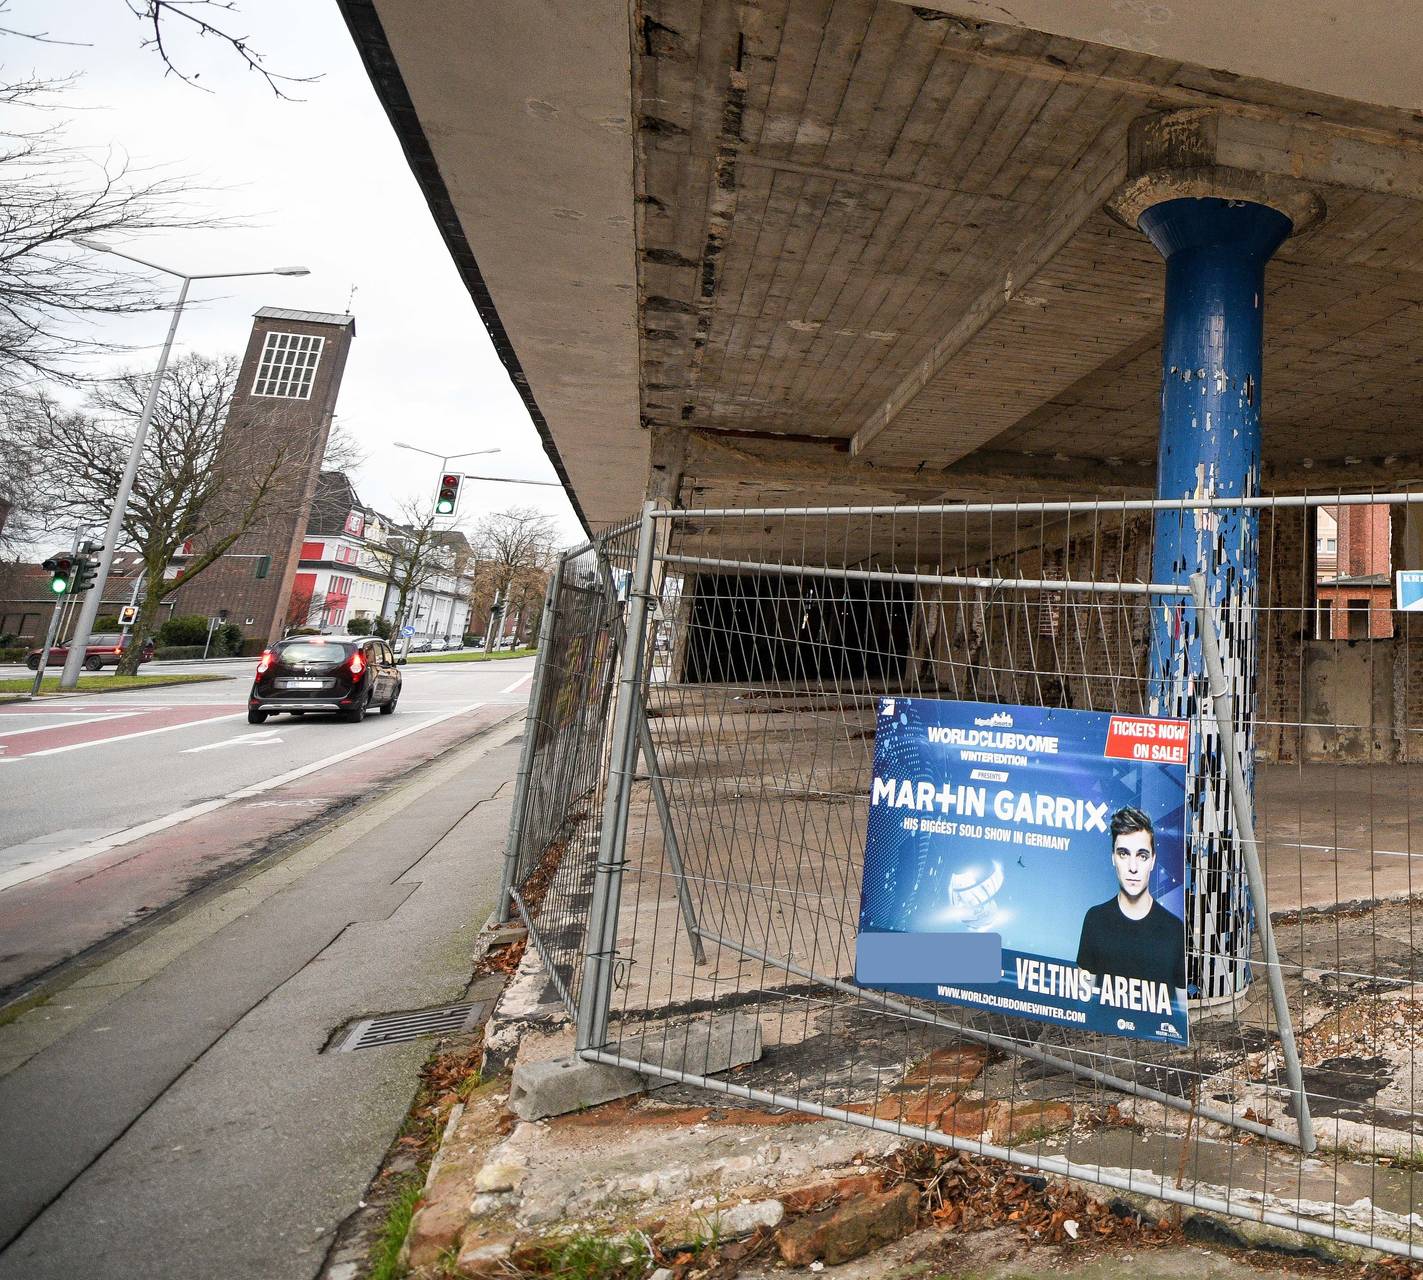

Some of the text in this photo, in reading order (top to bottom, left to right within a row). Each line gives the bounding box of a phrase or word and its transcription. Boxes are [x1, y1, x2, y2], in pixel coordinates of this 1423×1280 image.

[1112, 720, 1186, 740] TICKETS NOW
[1133, 743, 1184, 761] ON SALE!
[977, 771, 1002, 781] PRESENTS
[993, 789, 1109, 833] GARRIX
[903, 817, 1070, 851] HIS BIGGEST SOLO SHOW IN GERMANY
[1015, 957, 1173, 1016] VELTINS-ARENA
[937, 984, 1086, 1024] WWW.WORLDCLUBDOMEWINTER.COM
